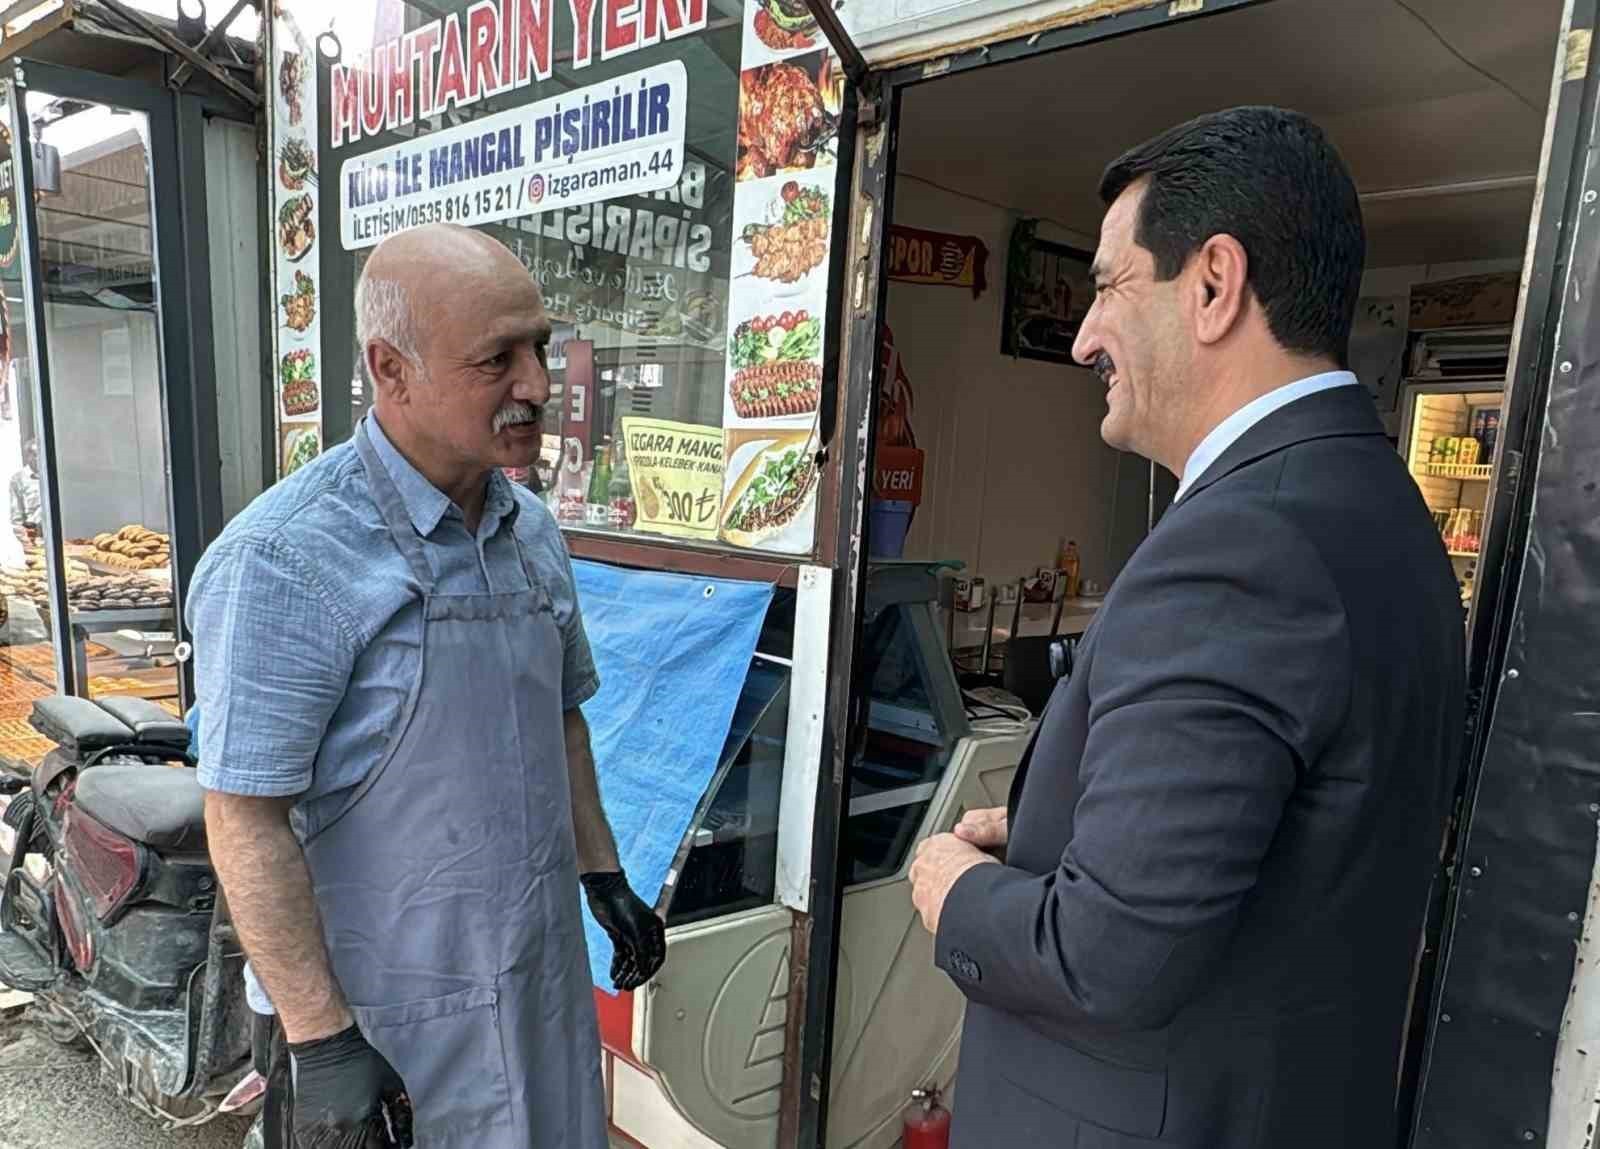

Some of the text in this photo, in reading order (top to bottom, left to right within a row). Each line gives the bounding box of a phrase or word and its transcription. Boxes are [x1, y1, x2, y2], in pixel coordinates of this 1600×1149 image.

[331, 0, 708, 149] MUHTARIN YE
[348, 78, 671, 209] KİLO İLE MANGAL PİŞİRİLİR
[445, 193, 471, 223] 816
[475, 188, 492, 216] 15
[496, 183, 512, 212] 21
[547, 148, 673, 199] izgaraman.44
[631, 433, 722, 461] IZGARA MANG
[881, 465, 914, 490] YERİ
